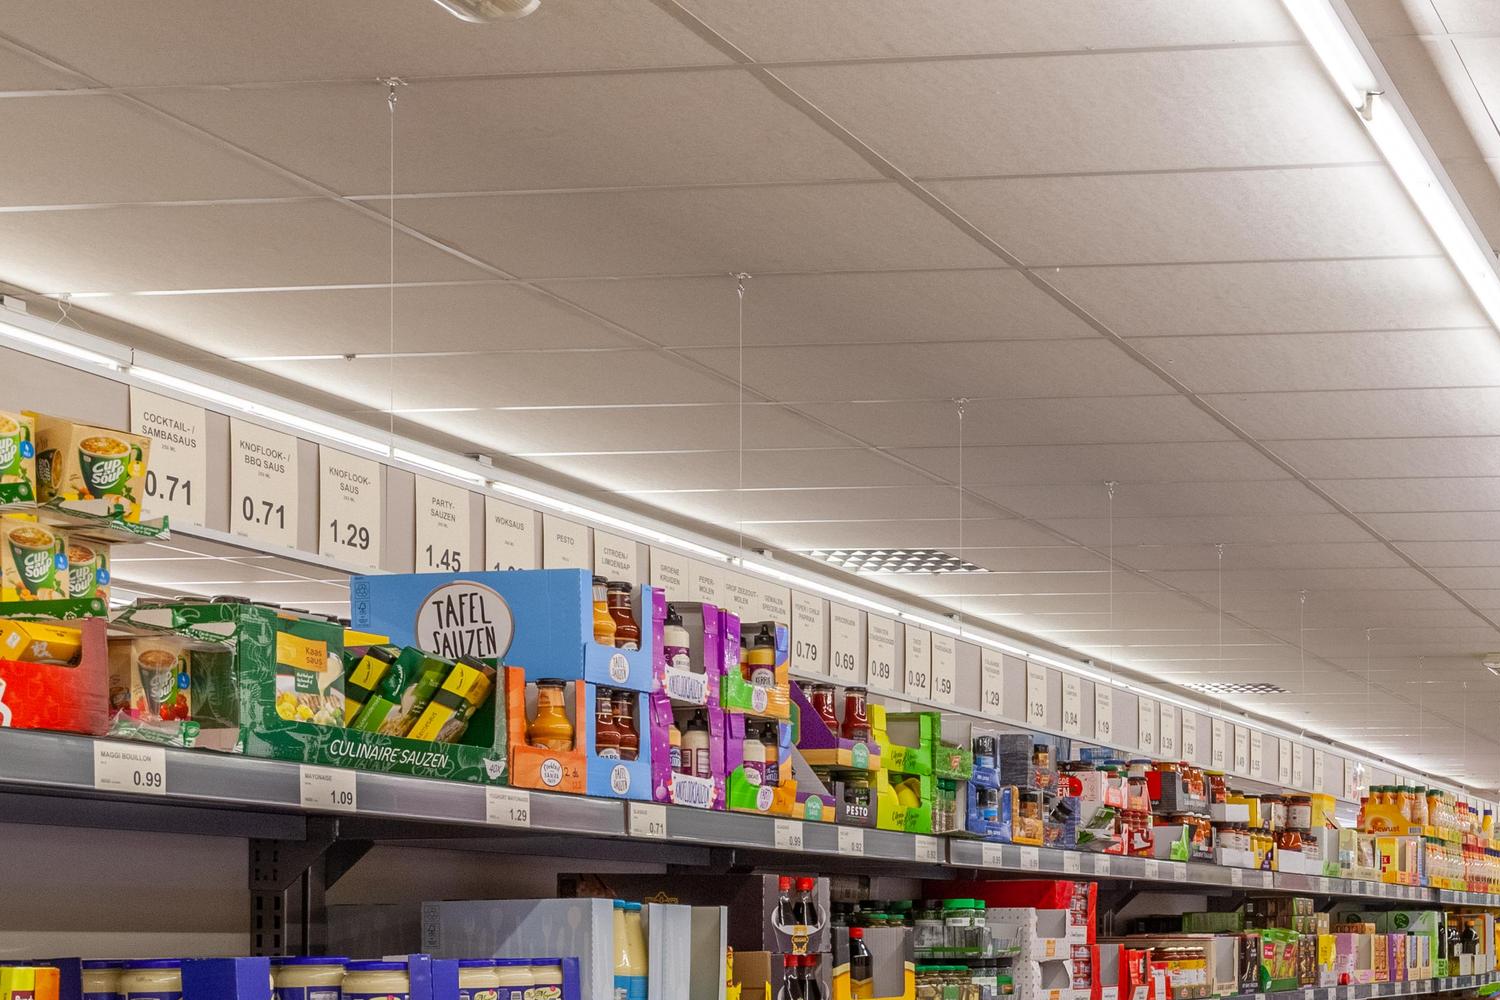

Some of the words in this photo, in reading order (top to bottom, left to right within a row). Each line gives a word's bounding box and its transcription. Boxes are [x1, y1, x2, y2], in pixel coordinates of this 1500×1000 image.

[143, 411, 191, 434] COCKTAIL-
[141, 424, 198, 448] SAMBASAUS
[239, 440, 287, 462] KNOFLOOK-
[244, 456, 262, 468] BBQ
[263, 459, 286, 474] SAUS
[328, 466, 372, 486] KNOFLOOK-
[144, 470, 192, 506] 0.71
[339, 482, 360, 495] SAUS
[242, 495, 285, 529] 0.71
[431, 496, 456, 510] PARTY-
[430, 508, 457, 523] SAUZEN
[494, 515, 525, 532] WOKSAUS
[329, 519, 371, 550] 1.29
[556, 533, 575, 546] PESTO
[425, 543, 461, 573] 1.45
[432, 590, 493, 629] TAFEL
[431, 624, 497, 660] SAUZEN
[796, 640, 818, 662] 0.79
[835, 651, 855, 671] 0.69
[871, 660, 890, 679] 0.89
[908, 670, 926, 689] 0.92
[935, 677, 952, 695] 1.59
[985, 689, 1000, 706] 1.29
[1030, 702, 1044, 718] 1.33
[100, 750, 122, 760] MAGGI
[329, 738, 399, 764] CULINAIRE
[399, 749, 449, 770] SAUZEN
[133, 770, 163, 788] 0.99
[330, 790, 353, 806] 1.09
[509, 809, 527, 822] 1.29
[846, 804, 868, 817] PESTO
[649, 822, 664, 835] 0.71
